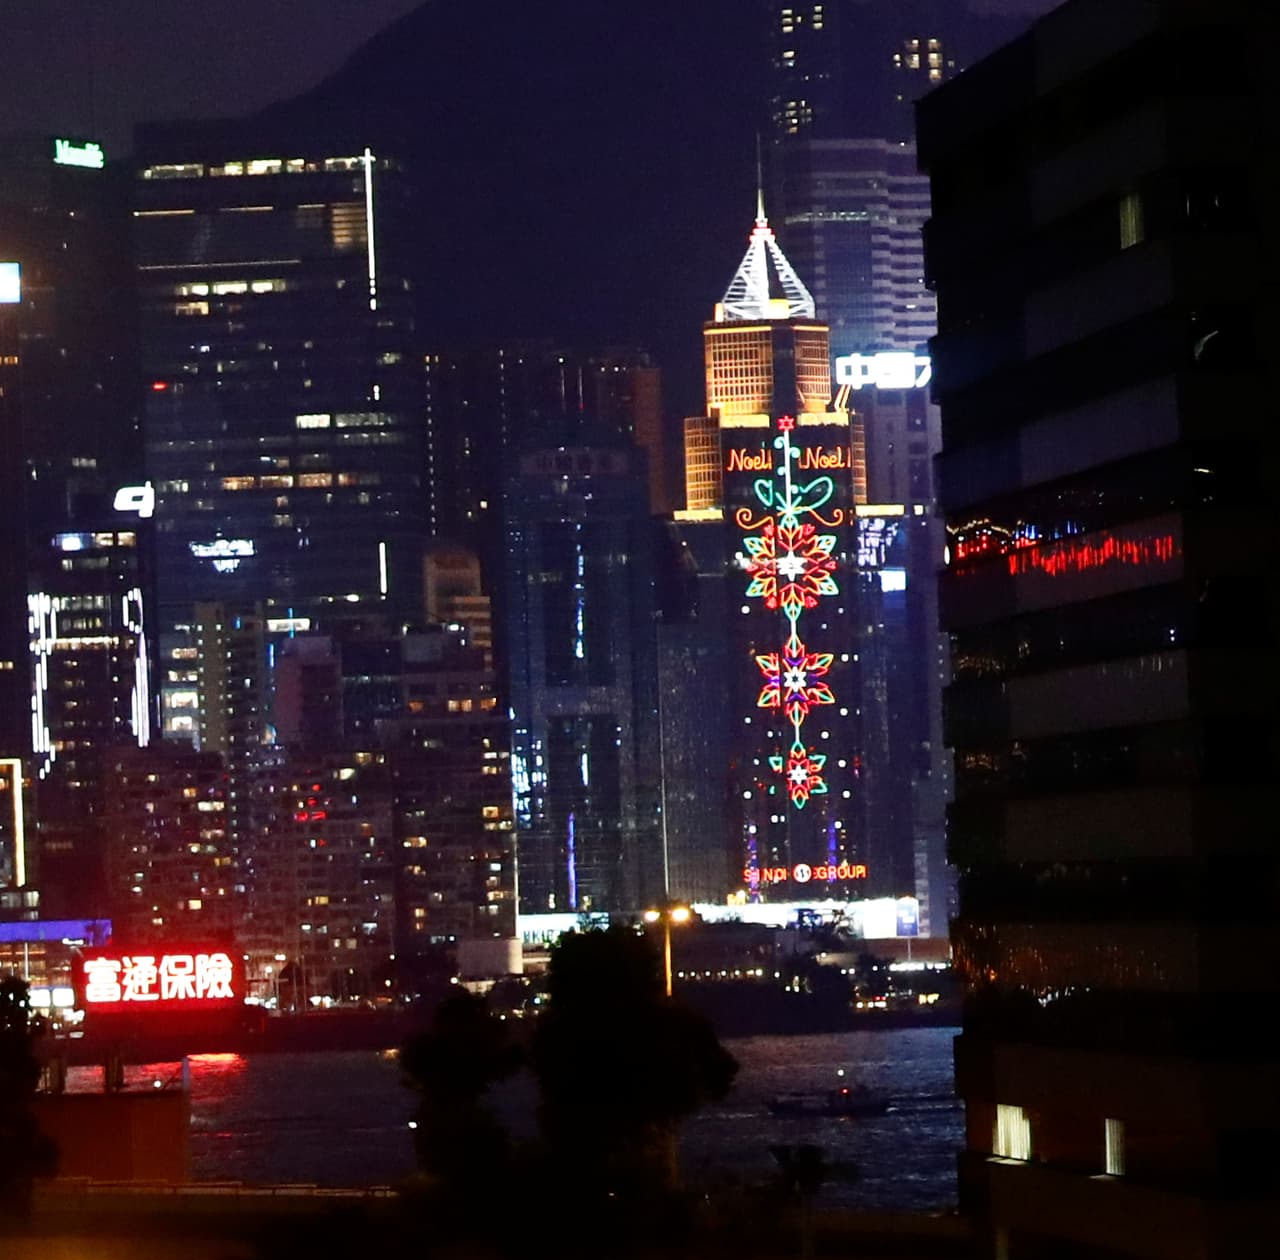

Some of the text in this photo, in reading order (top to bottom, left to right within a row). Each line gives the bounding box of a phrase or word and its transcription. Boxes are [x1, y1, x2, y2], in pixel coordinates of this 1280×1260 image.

[727, 448, 769, 472] Noel
[800, 446, 846, 470] Noel
[84, 952, 235, 1003] 富通保險
